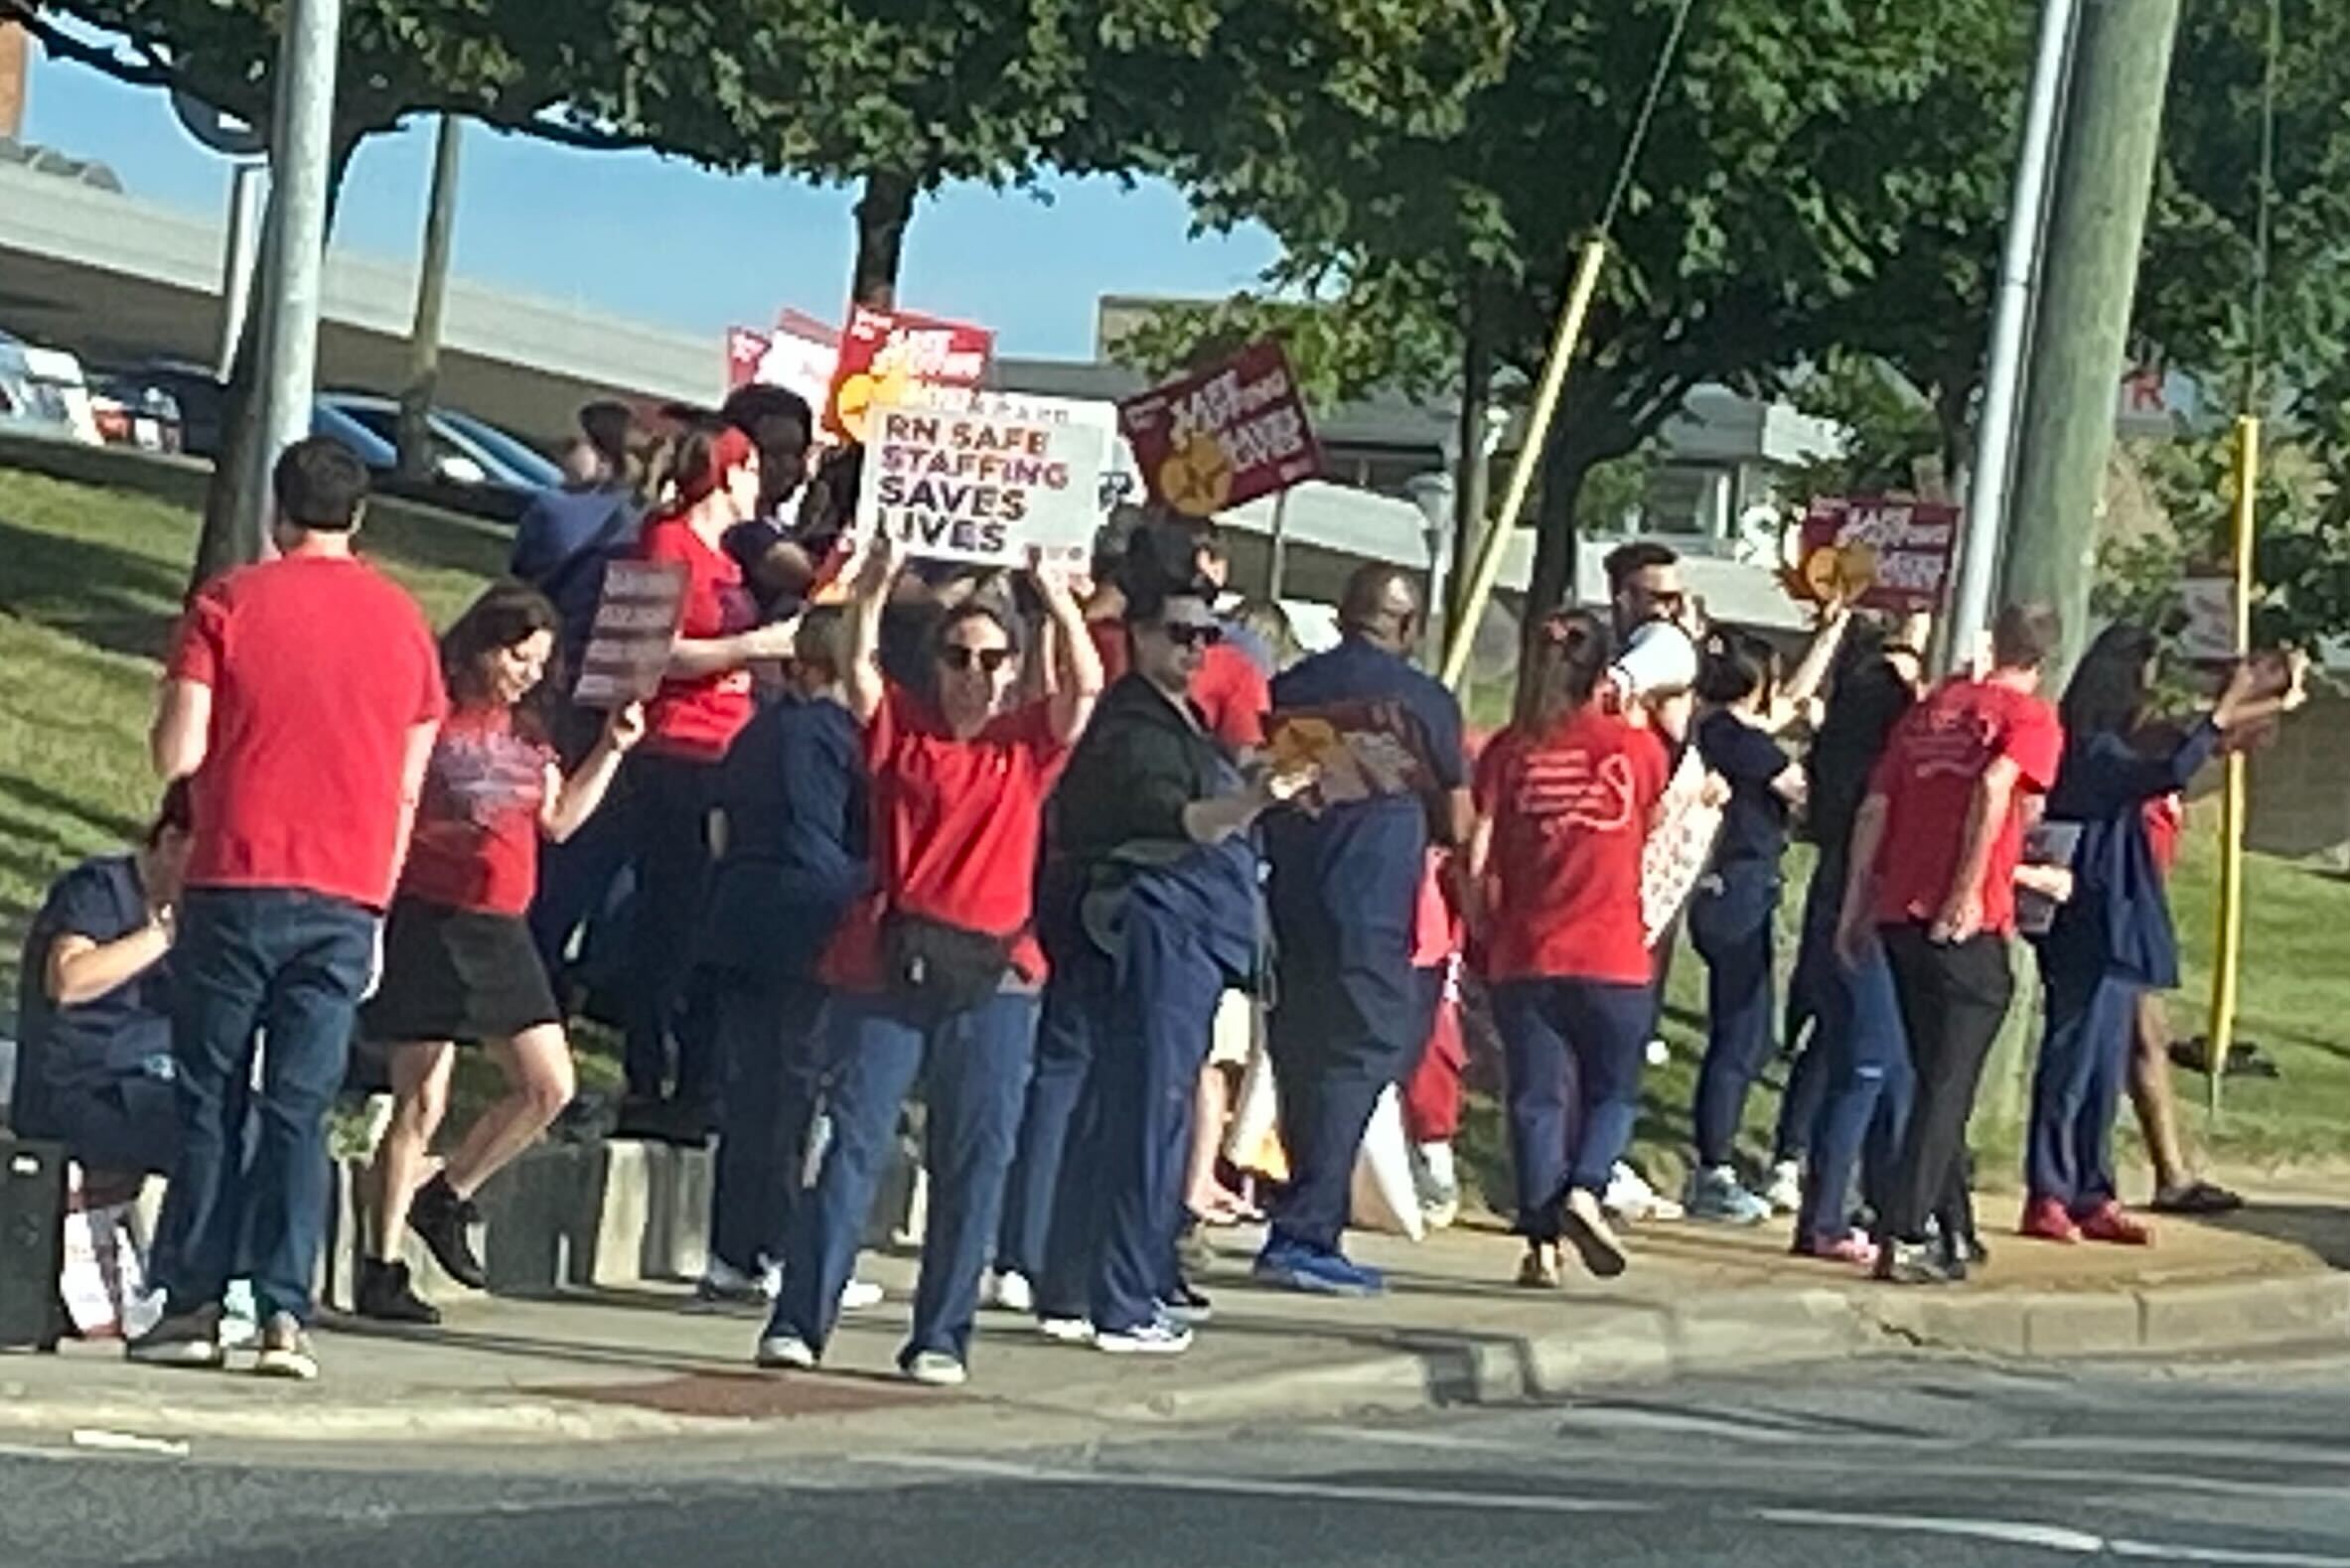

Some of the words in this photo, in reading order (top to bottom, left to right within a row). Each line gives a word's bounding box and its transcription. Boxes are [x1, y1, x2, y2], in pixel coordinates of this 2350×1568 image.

[885, 413, 941, 445] RN
[950, 421, 1051, 455] SAFE
[881, 445, 1070, 490] STAFFING
[877, 475, 1028, 521] SAVES
